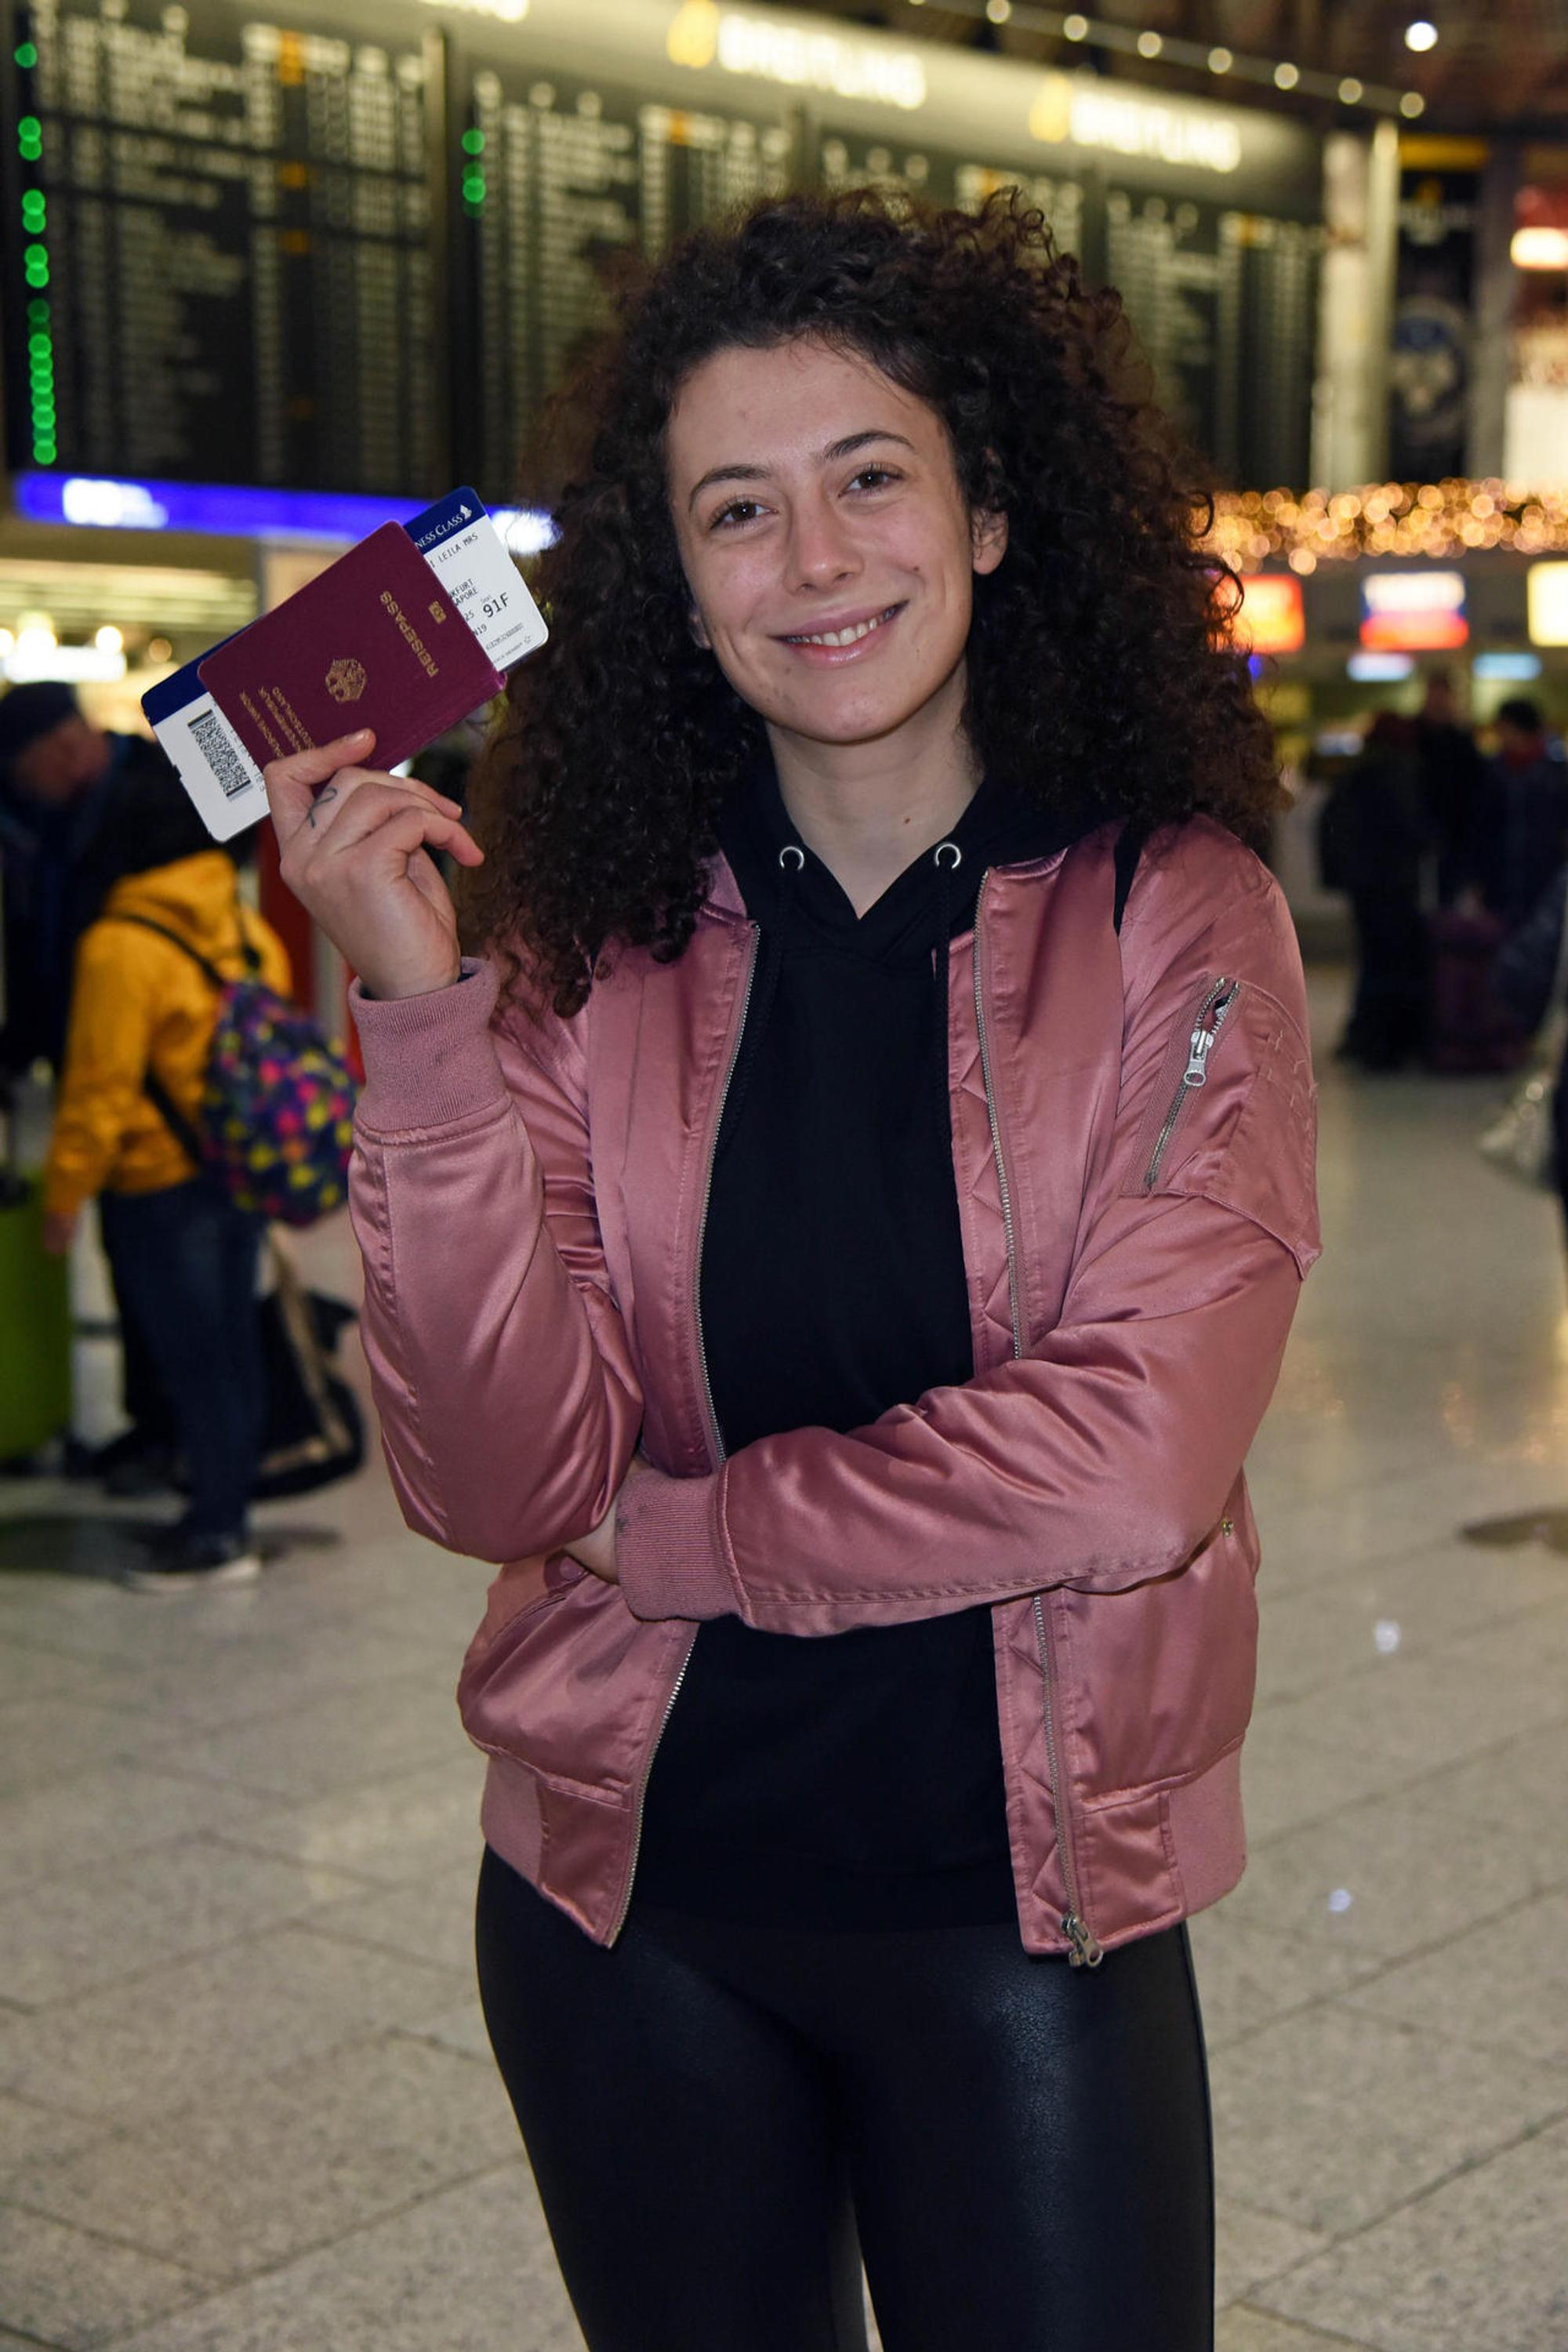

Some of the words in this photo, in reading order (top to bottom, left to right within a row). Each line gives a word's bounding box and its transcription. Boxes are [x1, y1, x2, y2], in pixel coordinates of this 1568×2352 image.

[435, 514, 463, 535] CLASS
[438, 544, 461, 562] LEILA
[463, 532, 478, 546] MRS
[482, 592, 509, 618] 91F
[380, 590, 439, 677] REISEPASS
